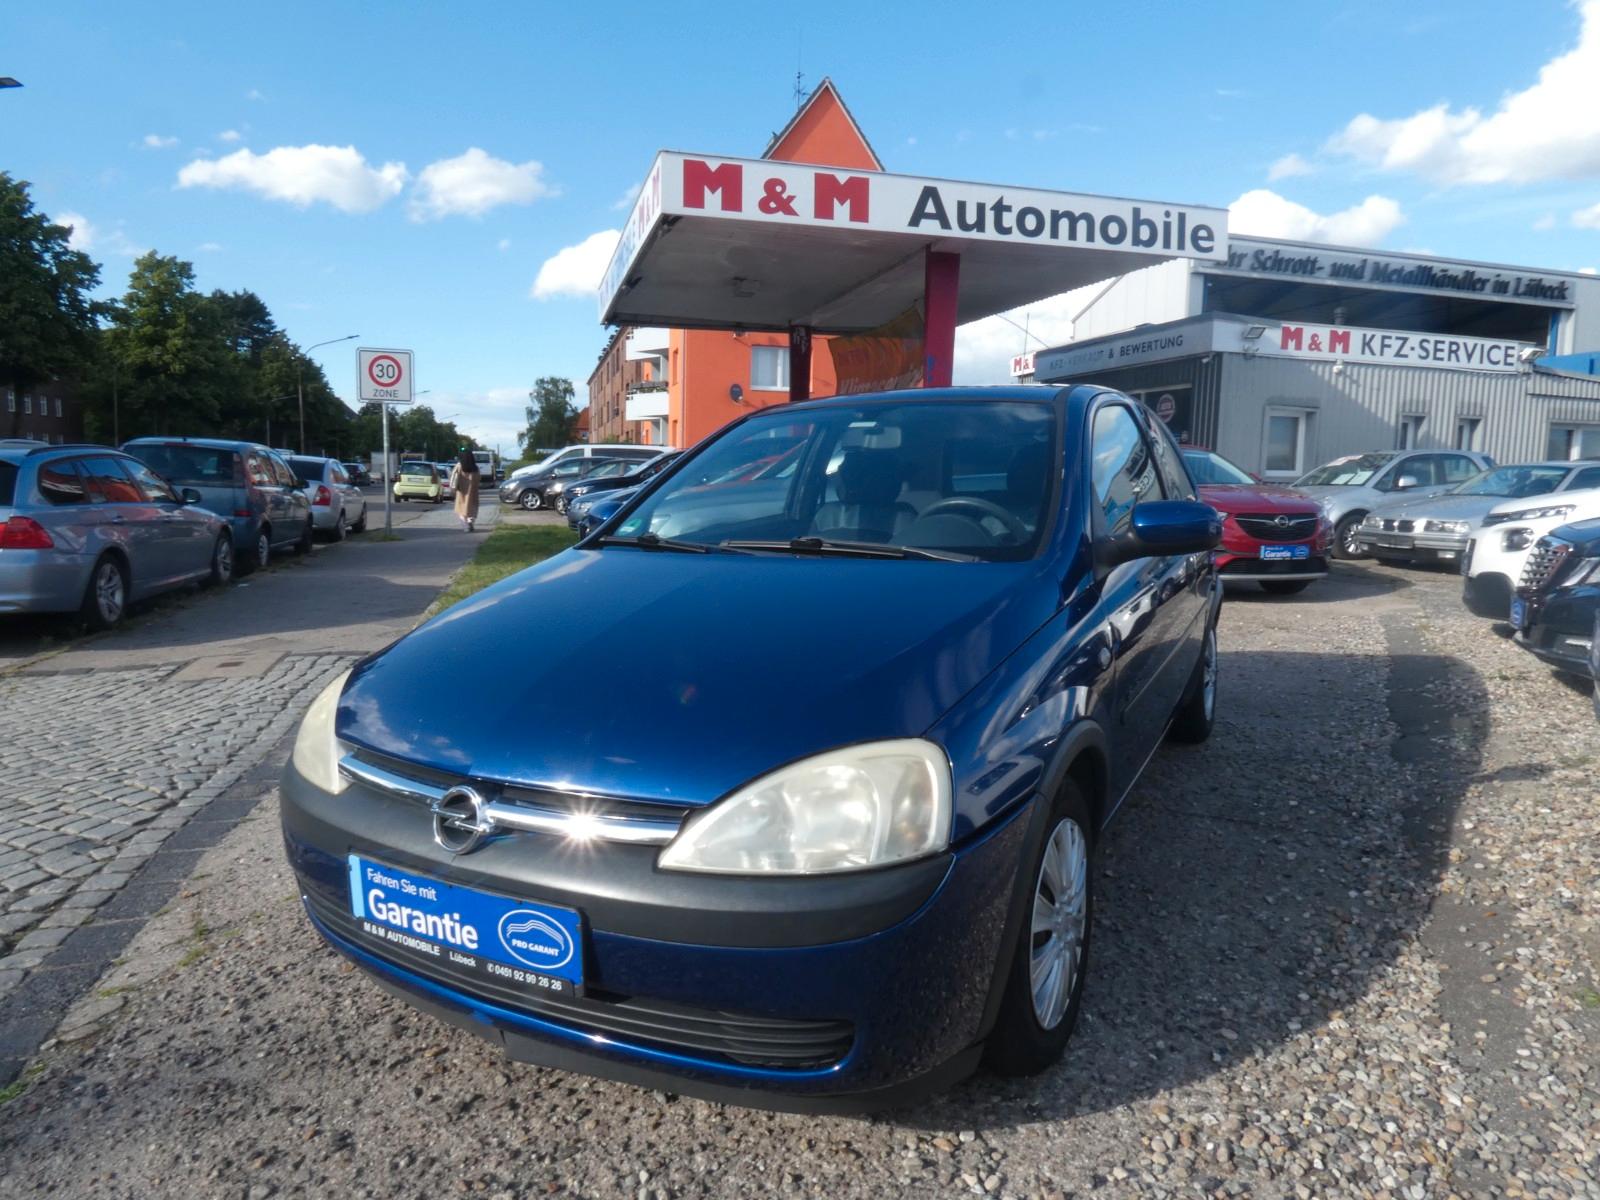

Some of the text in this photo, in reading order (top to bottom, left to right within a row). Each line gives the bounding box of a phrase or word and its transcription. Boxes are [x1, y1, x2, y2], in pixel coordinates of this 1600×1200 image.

[682, 159, 1215, 254] M & M Automobile
[1214, 245, 1569, 300] hr Schrott- und Metallhändler in Lübeck
[1120, 335, 1184, 357] BEWERTUNG
[1280, 326, 1304, 350] M
[1308, 333, 1322, 352] &
[1329, 329, 1351, 354] M
[375, 363, 396, 379] 30
[373, 388, 399, 398] ZONE
[367, 868, 437, 901] Fahren Sie mit
[368, 888, 479, 950] Garantie
[363, 922, 371, 932] M
[371, 924, 377, 935] &
[378, 927, 385, 937] M
[386, 931, 441, 956] AUTOMOBILE
[449, 951, 476, 967] Lübeck
[511, 938, 560, 957] PRO GARANT
